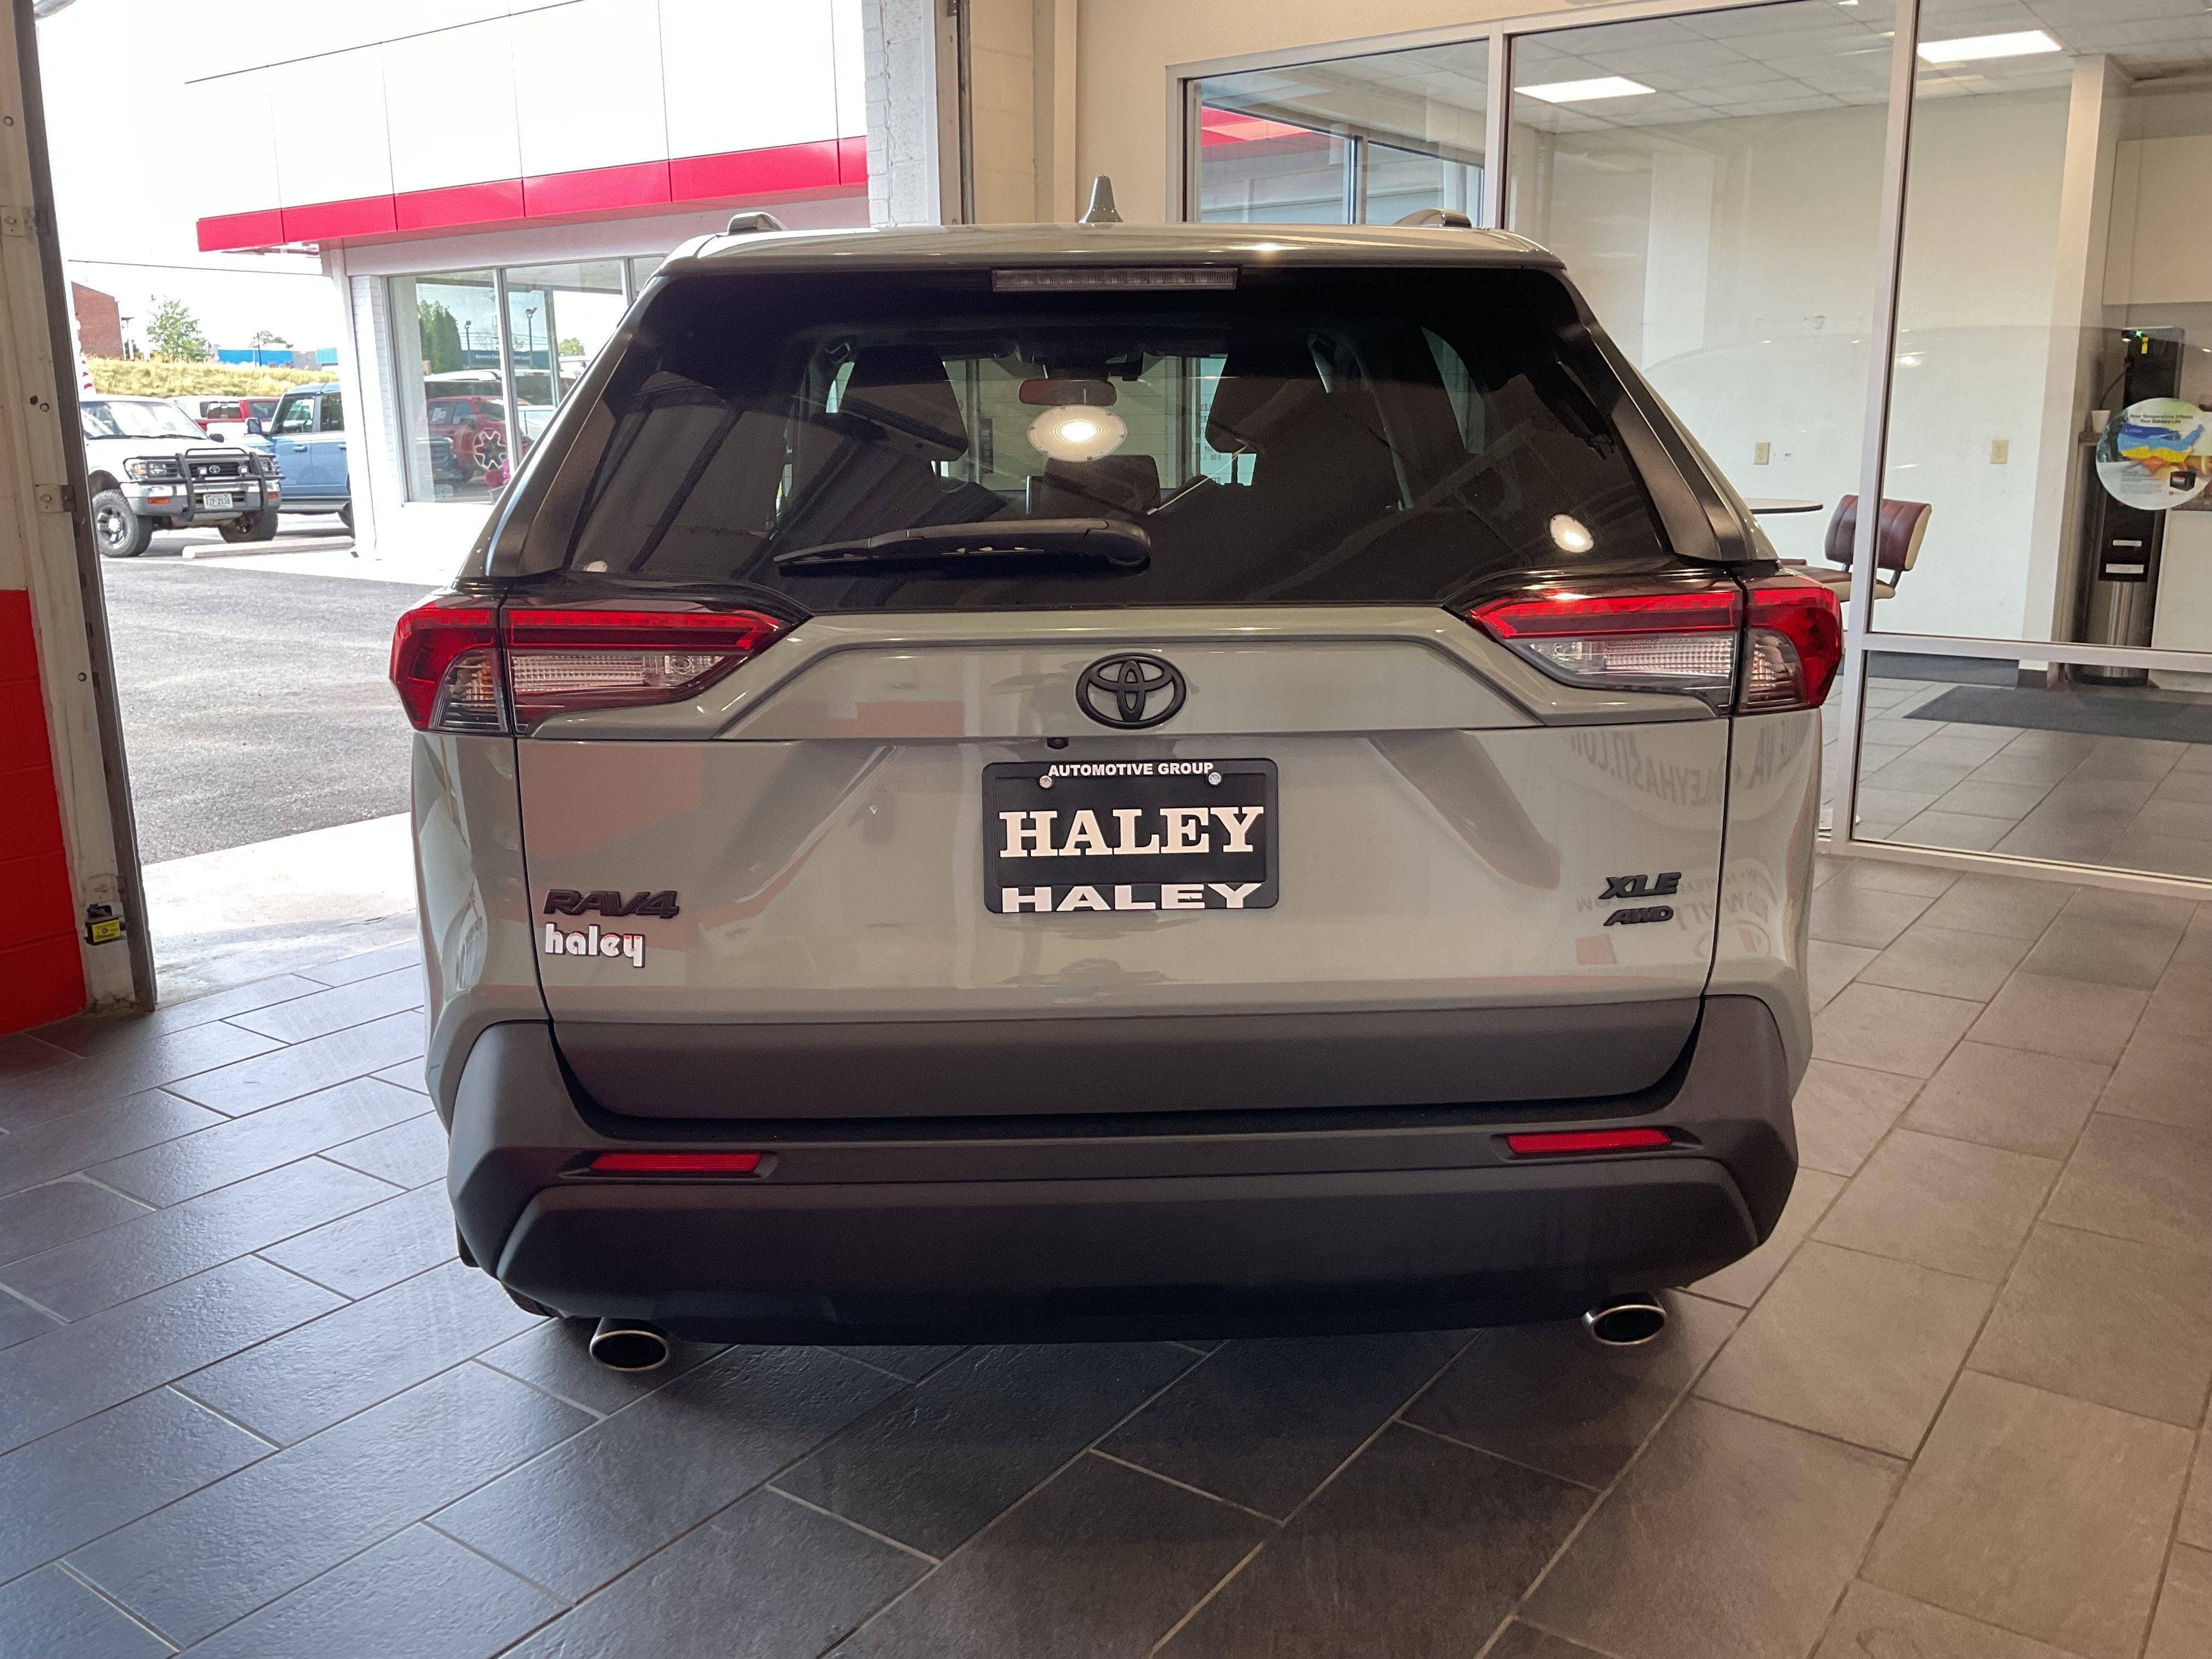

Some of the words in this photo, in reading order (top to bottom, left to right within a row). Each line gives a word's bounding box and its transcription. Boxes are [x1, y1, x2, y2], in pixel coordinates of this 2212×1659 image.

[1048, 763, 1153, 777] AUTOMOTIVE
[1158, 762, 1214, 775] GROUP
[998, 806, 1264, 858] HALEY
[1001, 883, 1262, 913] HALEY
[1598, 872, 1681, 899] XLE
[543, 889, 680, 919] RAV4
[1603, 905, 1674, 926] AWD
[544, 922, 645, 968] haley
